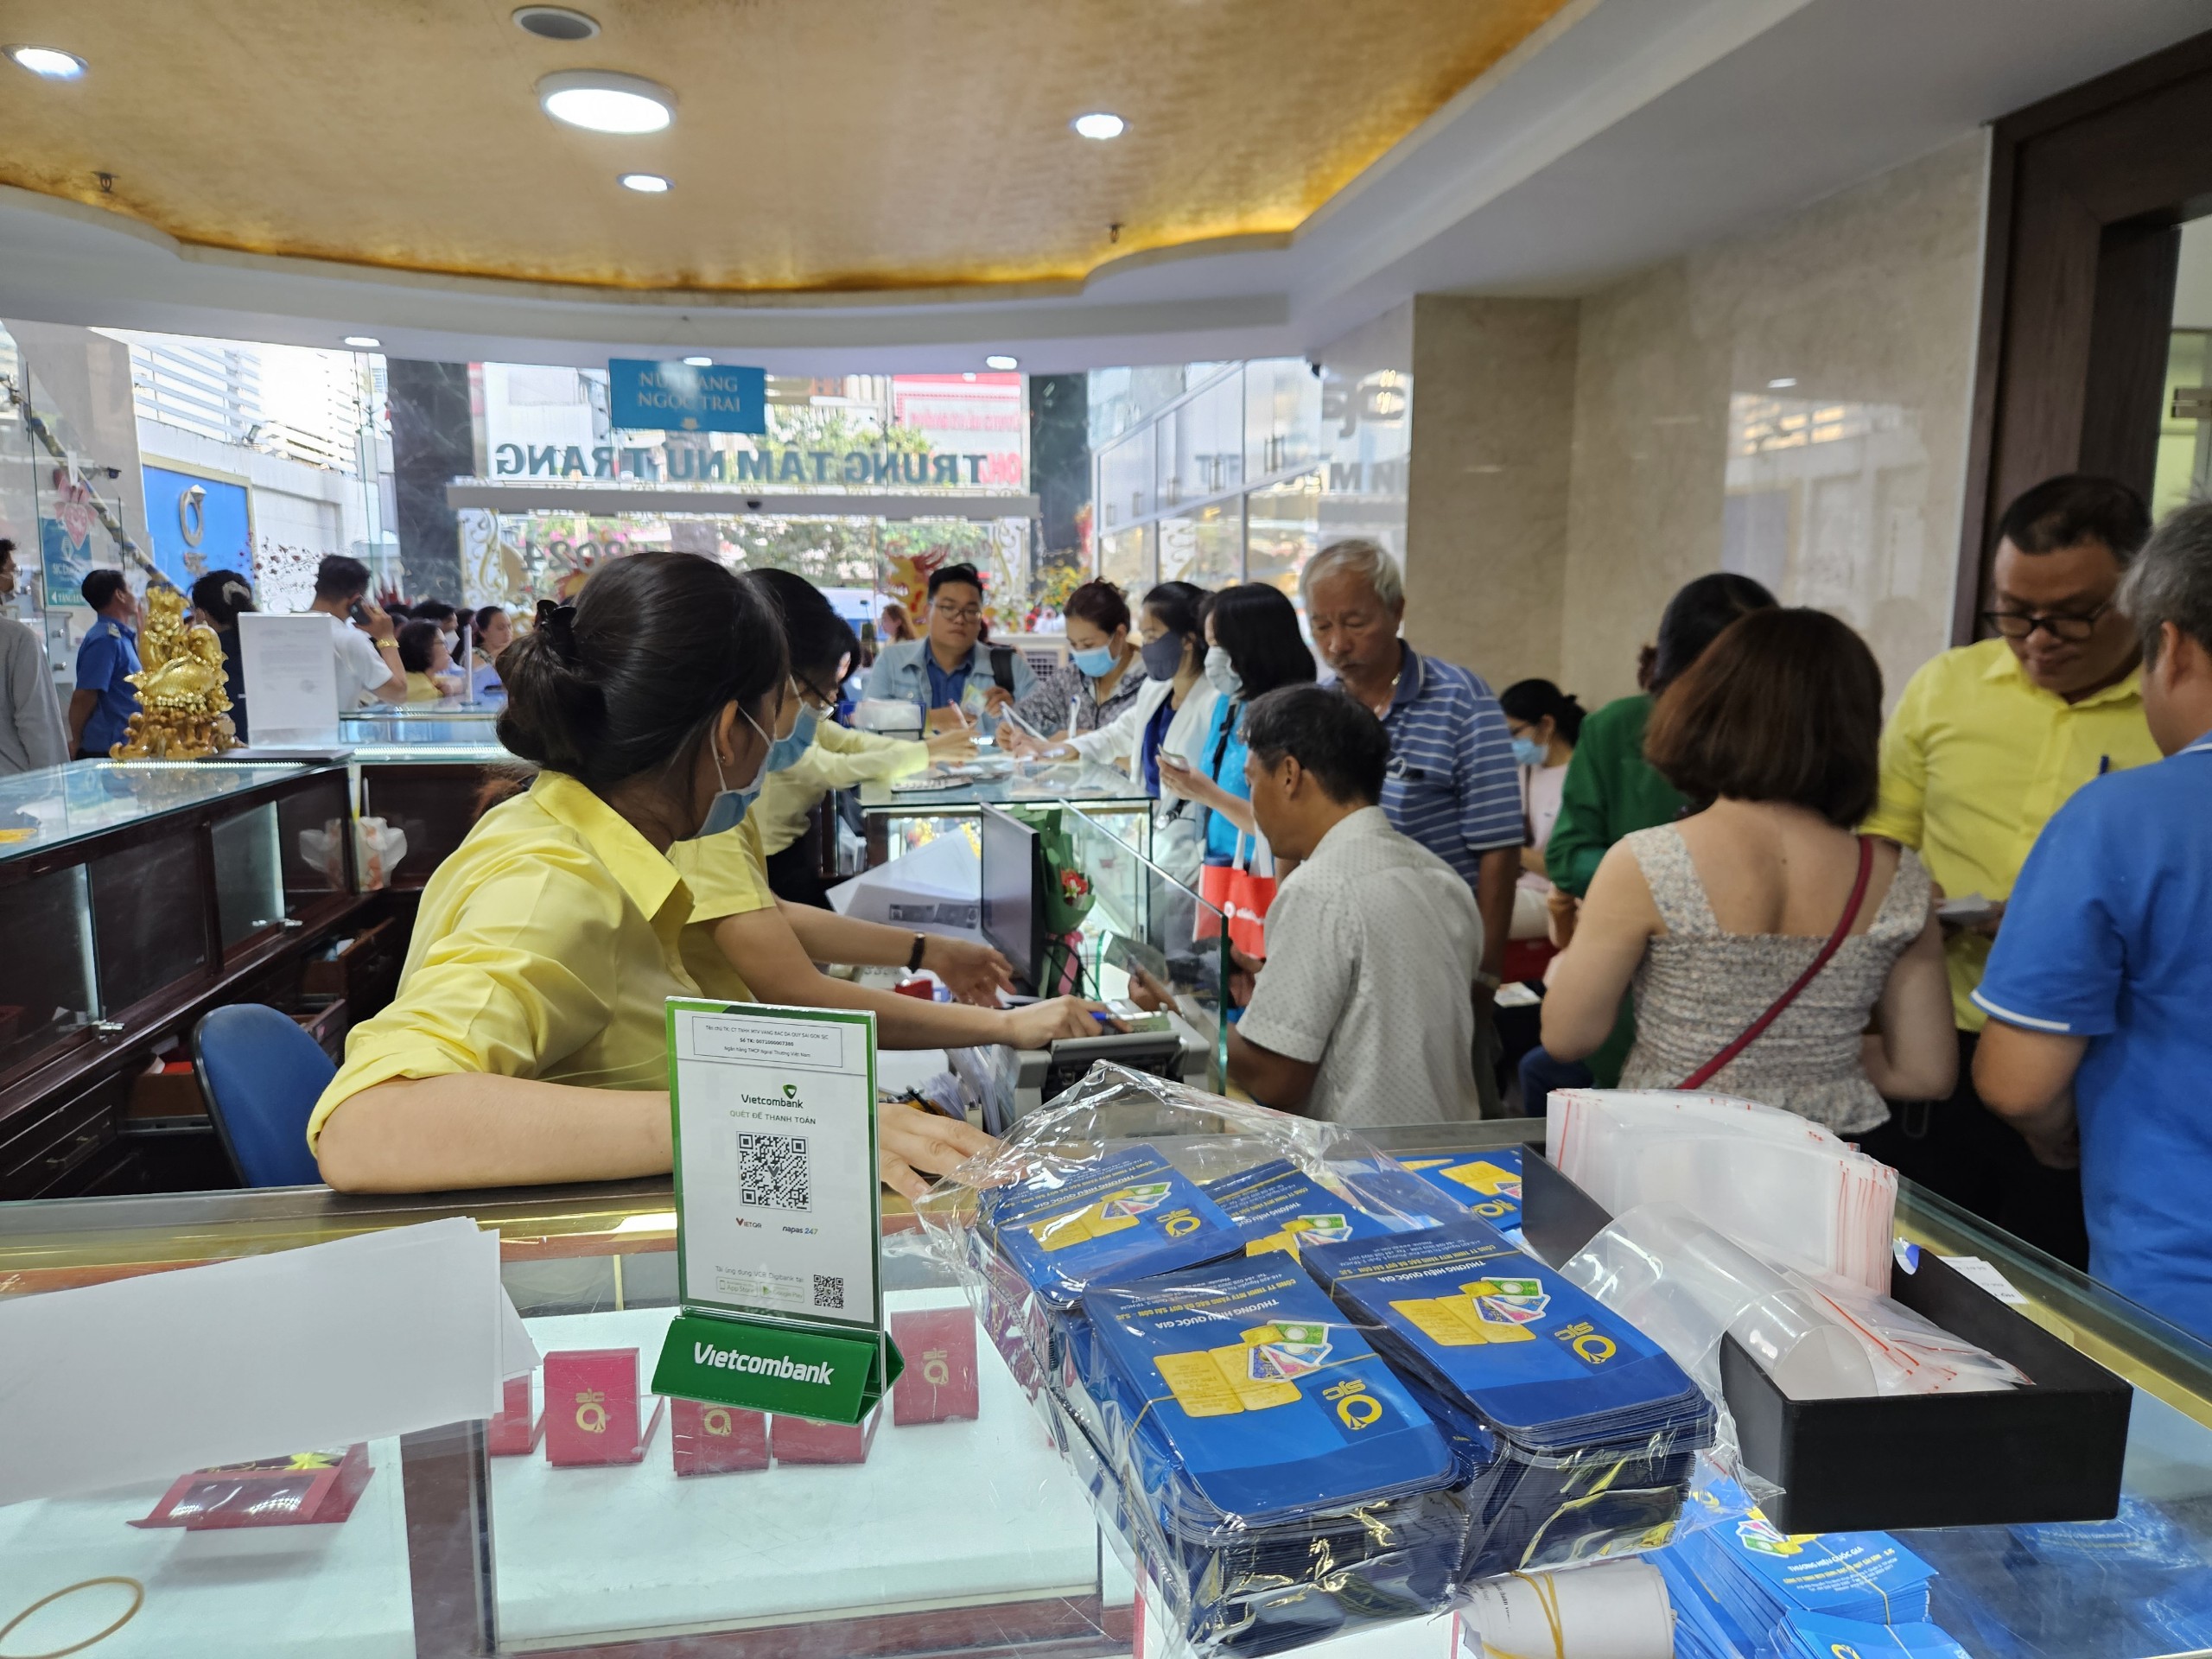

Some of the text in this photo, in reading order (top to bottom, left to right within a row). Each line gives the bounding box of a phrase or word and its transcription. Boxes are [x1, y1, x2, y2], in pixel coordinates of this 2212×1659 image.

[702, 395, 741, 413] TRAI
[740, 1093, 804, 1108] Vietcombank
[729, 1109, 750, 1118] QUÉT
[764, 1113, 791, 1122] THANH
[794, 1115, 816, 1124] TOÁN
[1033, 1200, 1049, 1209] GIA
[782, 1225, 803, 1234] napas
[1446, 1259, 1486, 1272] THƯƠNG
[1377, 1274, 1395, 1282] GIA
[1232, 1298, 1279, 1315] THƯƠNG
[1154, 1319, 1174, 1330] GIA
[1174, 1313, 1206, 1328] QUỐC
[1554, 1321, 1593, 1340] SJC
[693, 1340, 835, 1385] Vietcombank
[1322, 1379, 1365, 1400] SJC
